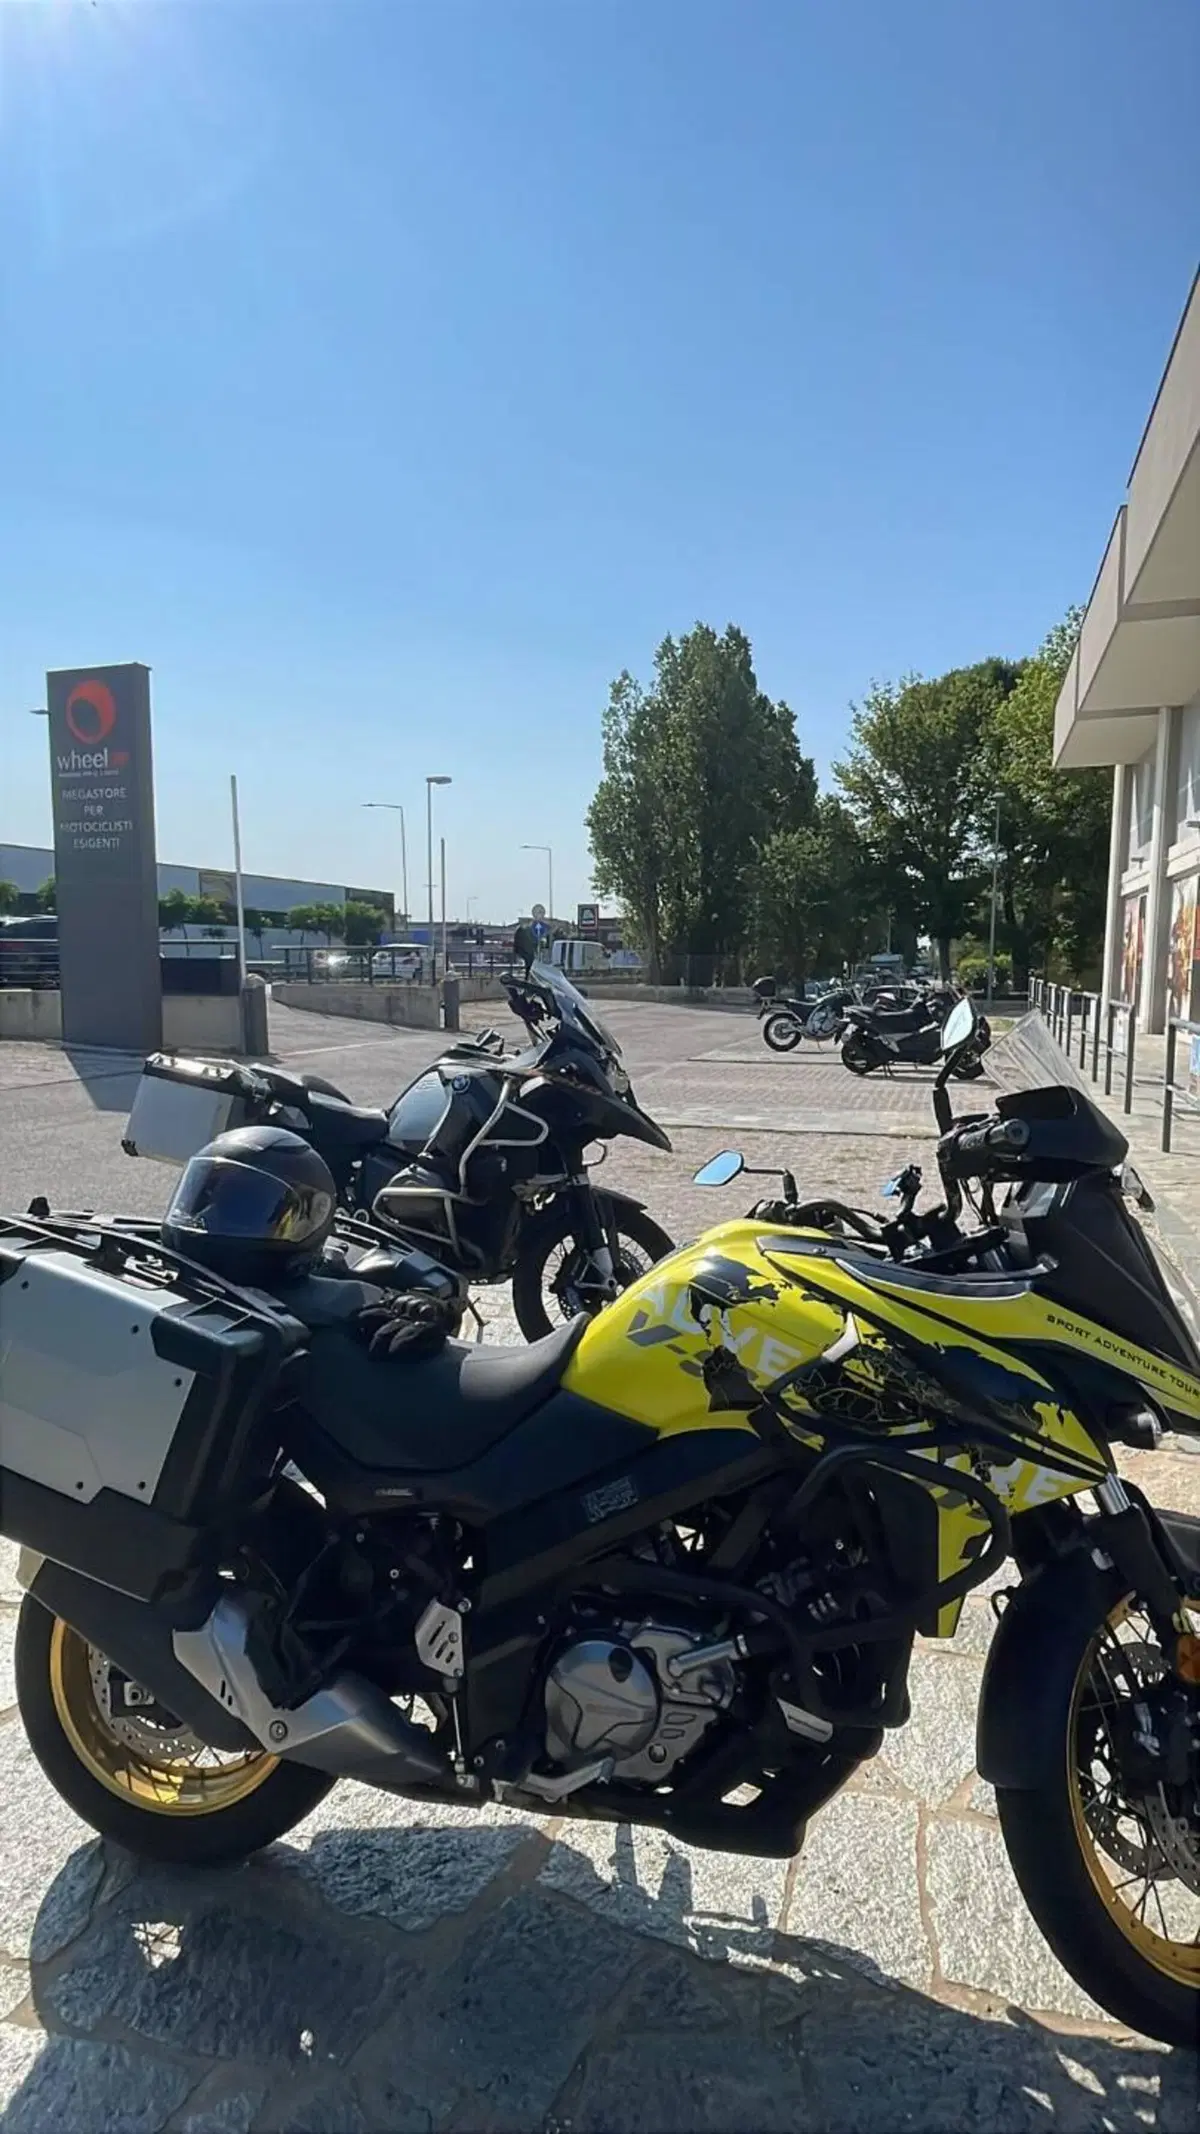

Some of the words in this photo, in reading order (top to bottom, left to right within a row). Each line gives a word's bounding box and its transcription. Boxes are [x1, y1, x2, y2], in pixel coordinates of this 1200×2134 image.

[61, 786, 128, 800] MEGASTORE
[83, 804, 105, 817] PER
[60, 820, 133, 833] MOTOCICLISTI
[73, 837, 120, 849] ESIGENTI
[1046, 1314, 1091, 1340] SPORT
[1093, 1336, 1167, 1379] ADVENTURE
